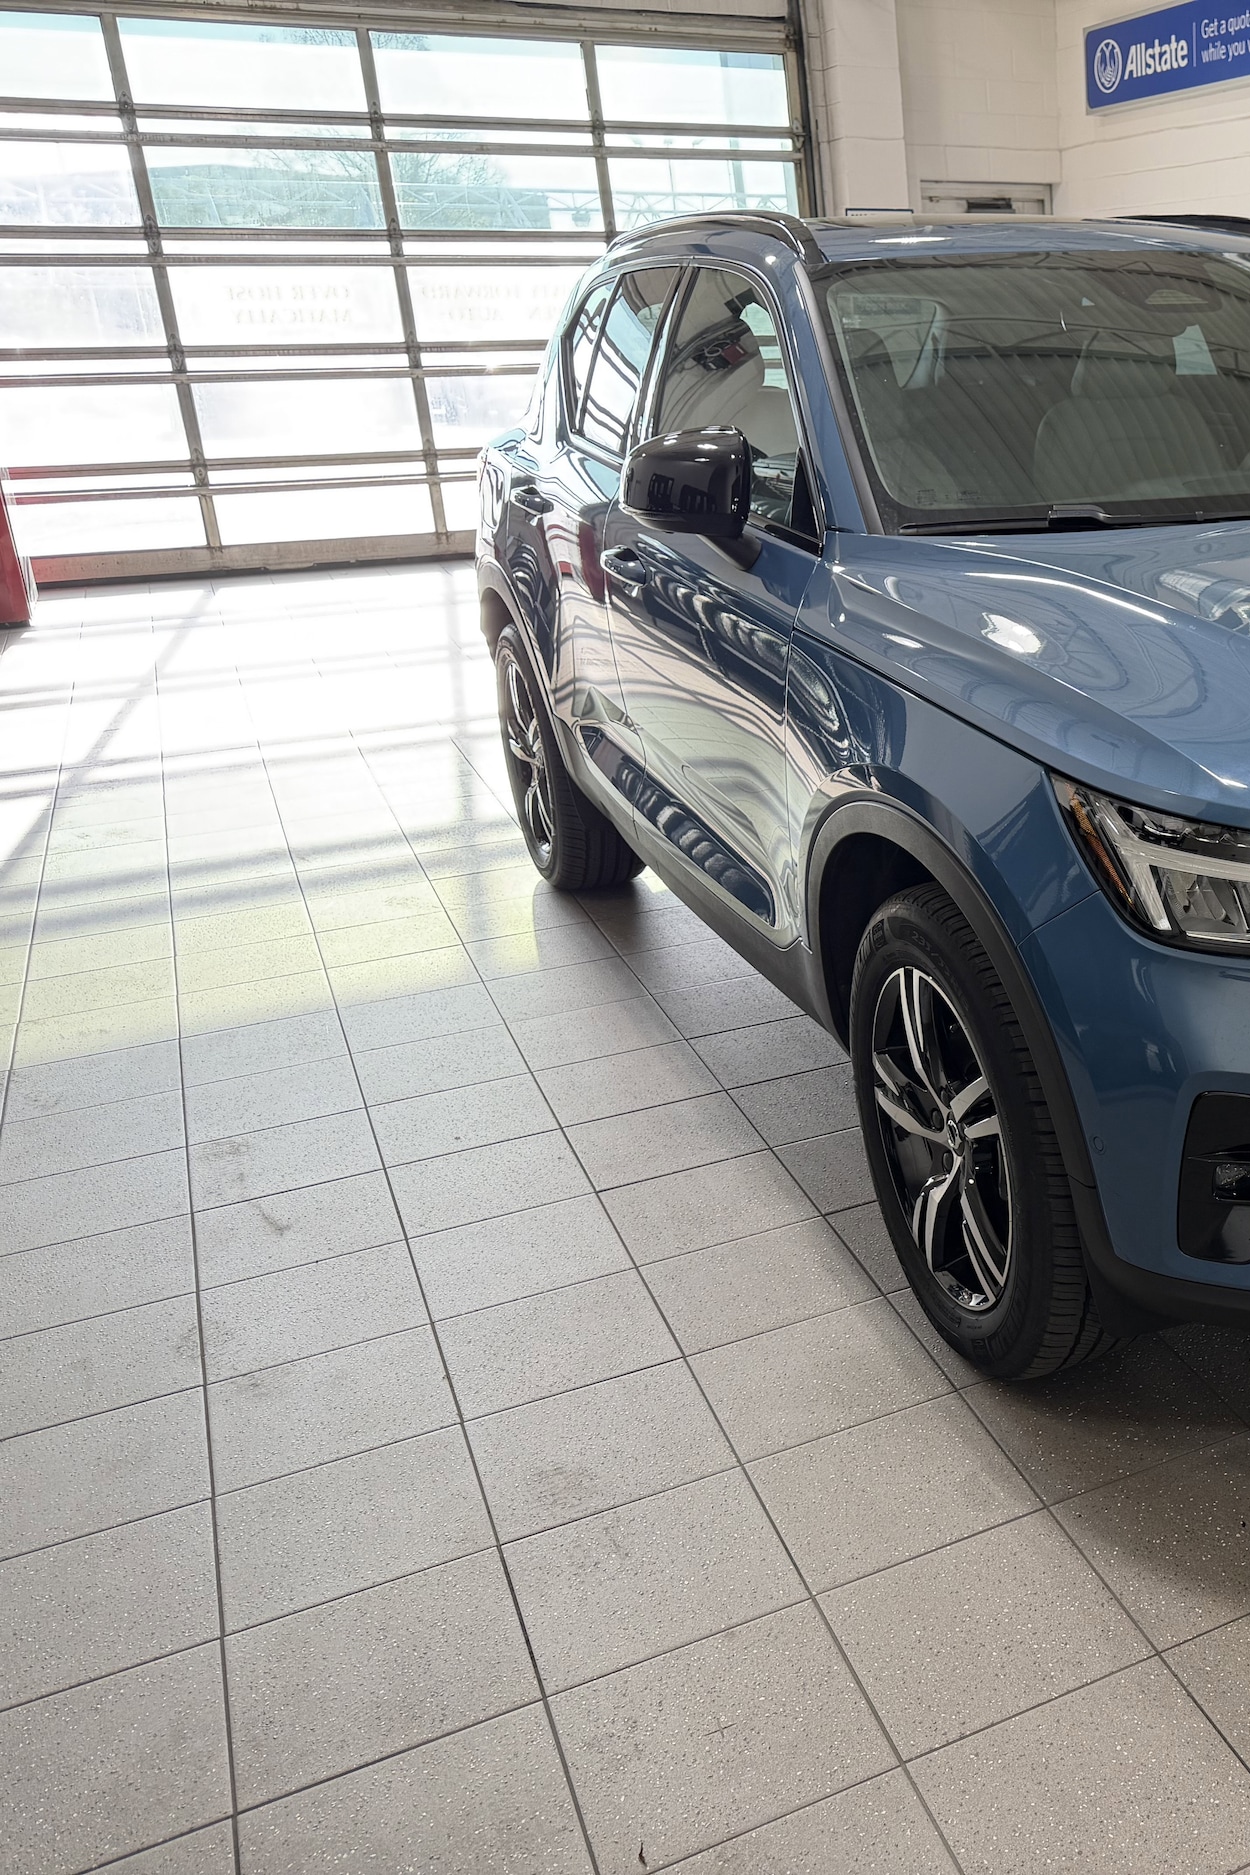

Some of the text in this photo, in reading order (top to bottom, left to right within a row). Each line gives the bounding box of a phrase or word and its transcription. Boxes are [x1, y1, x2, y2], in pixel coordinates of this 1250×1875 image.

[1201, 19, 1218, 39] Get
[1220, 20, 1226, 34] a
[1124, 35, 1188, 80] Allstate
[1201, 41, 1226, 63] while
[1227, 41, 1246, 62] you
